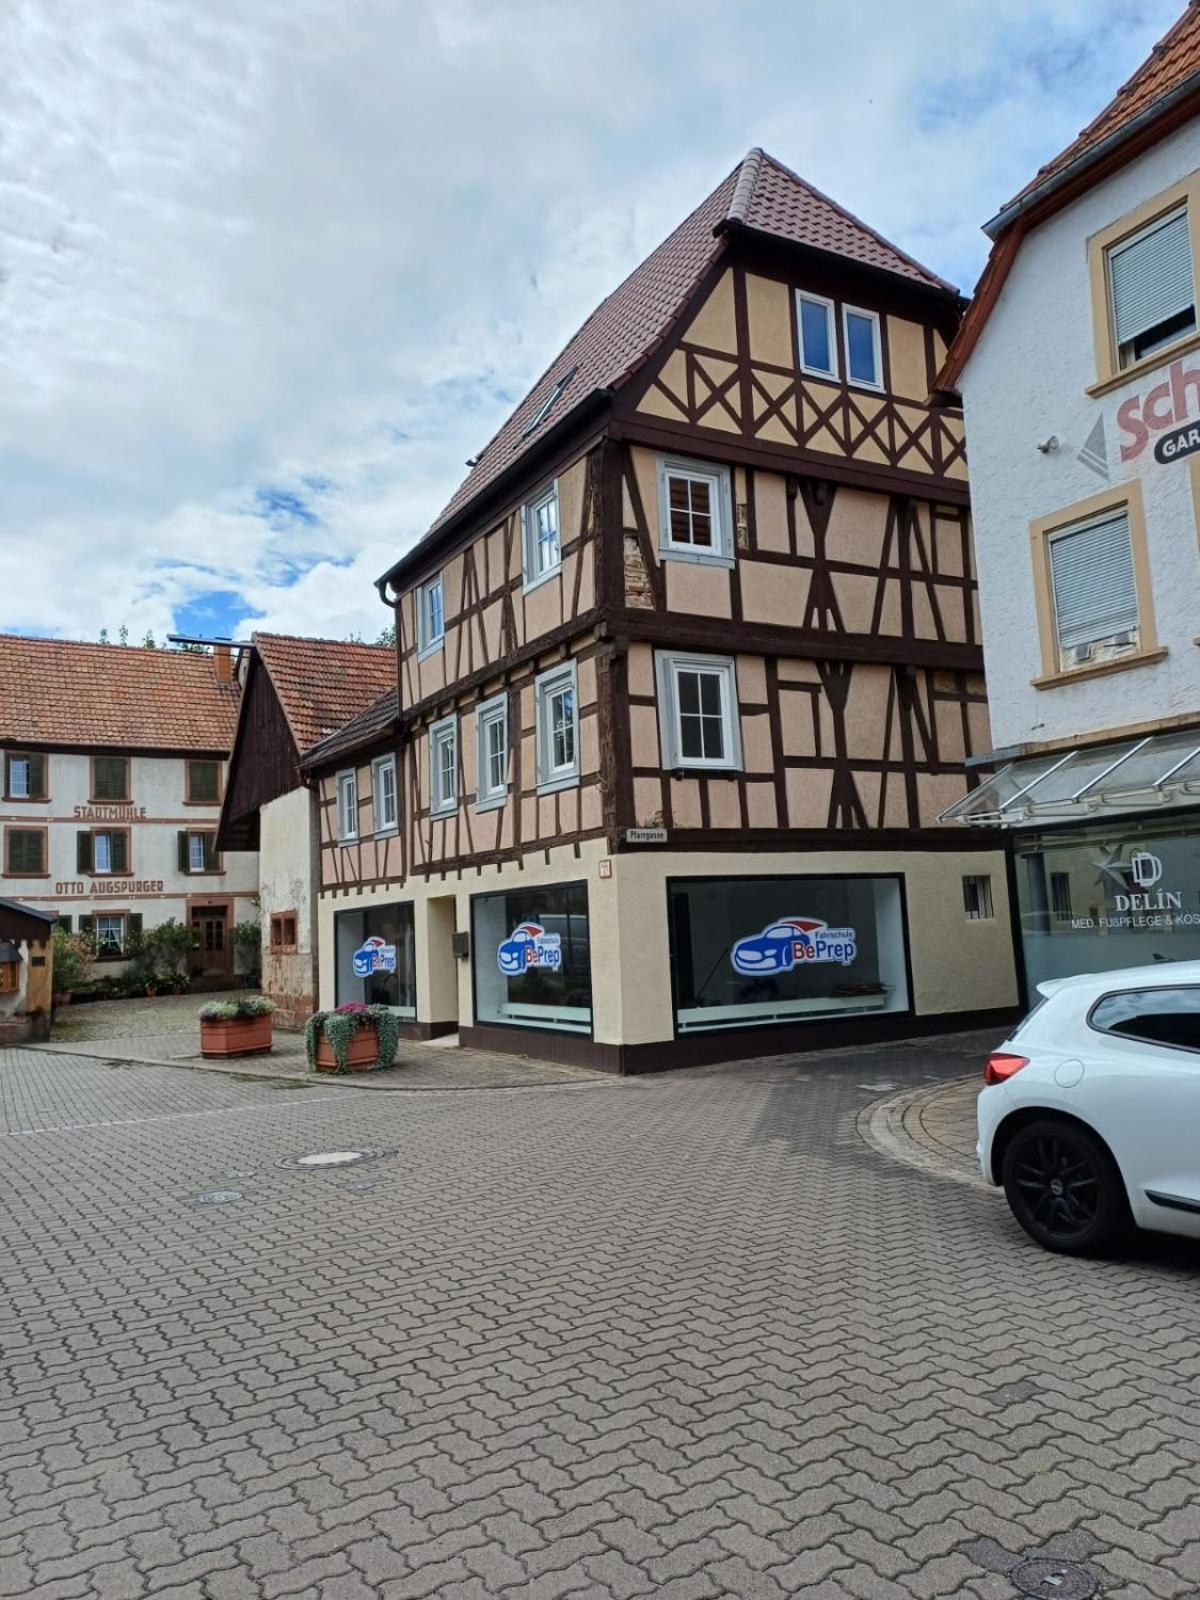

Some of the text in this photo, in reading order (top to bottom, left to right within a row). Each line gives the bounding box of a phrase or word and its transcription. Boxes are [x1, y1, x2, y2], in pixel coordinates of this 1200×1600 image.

[1162, 428, 1200, 457] GAR
[74, 803, 146, 819] STADTMÜHLE
[630, 831, 664, 841] Pfarrgasse
[55, 880, 164, 894] OTTO AUGSPURGER
[1114, 888, 1182, 911] DELÍN
[1165, 914, 1173, 925] &
[815, 929, 853, 939] Fahrschule
[525, 945, 560, 967] BePrep
[793, 940, 854, 962] BePrep
